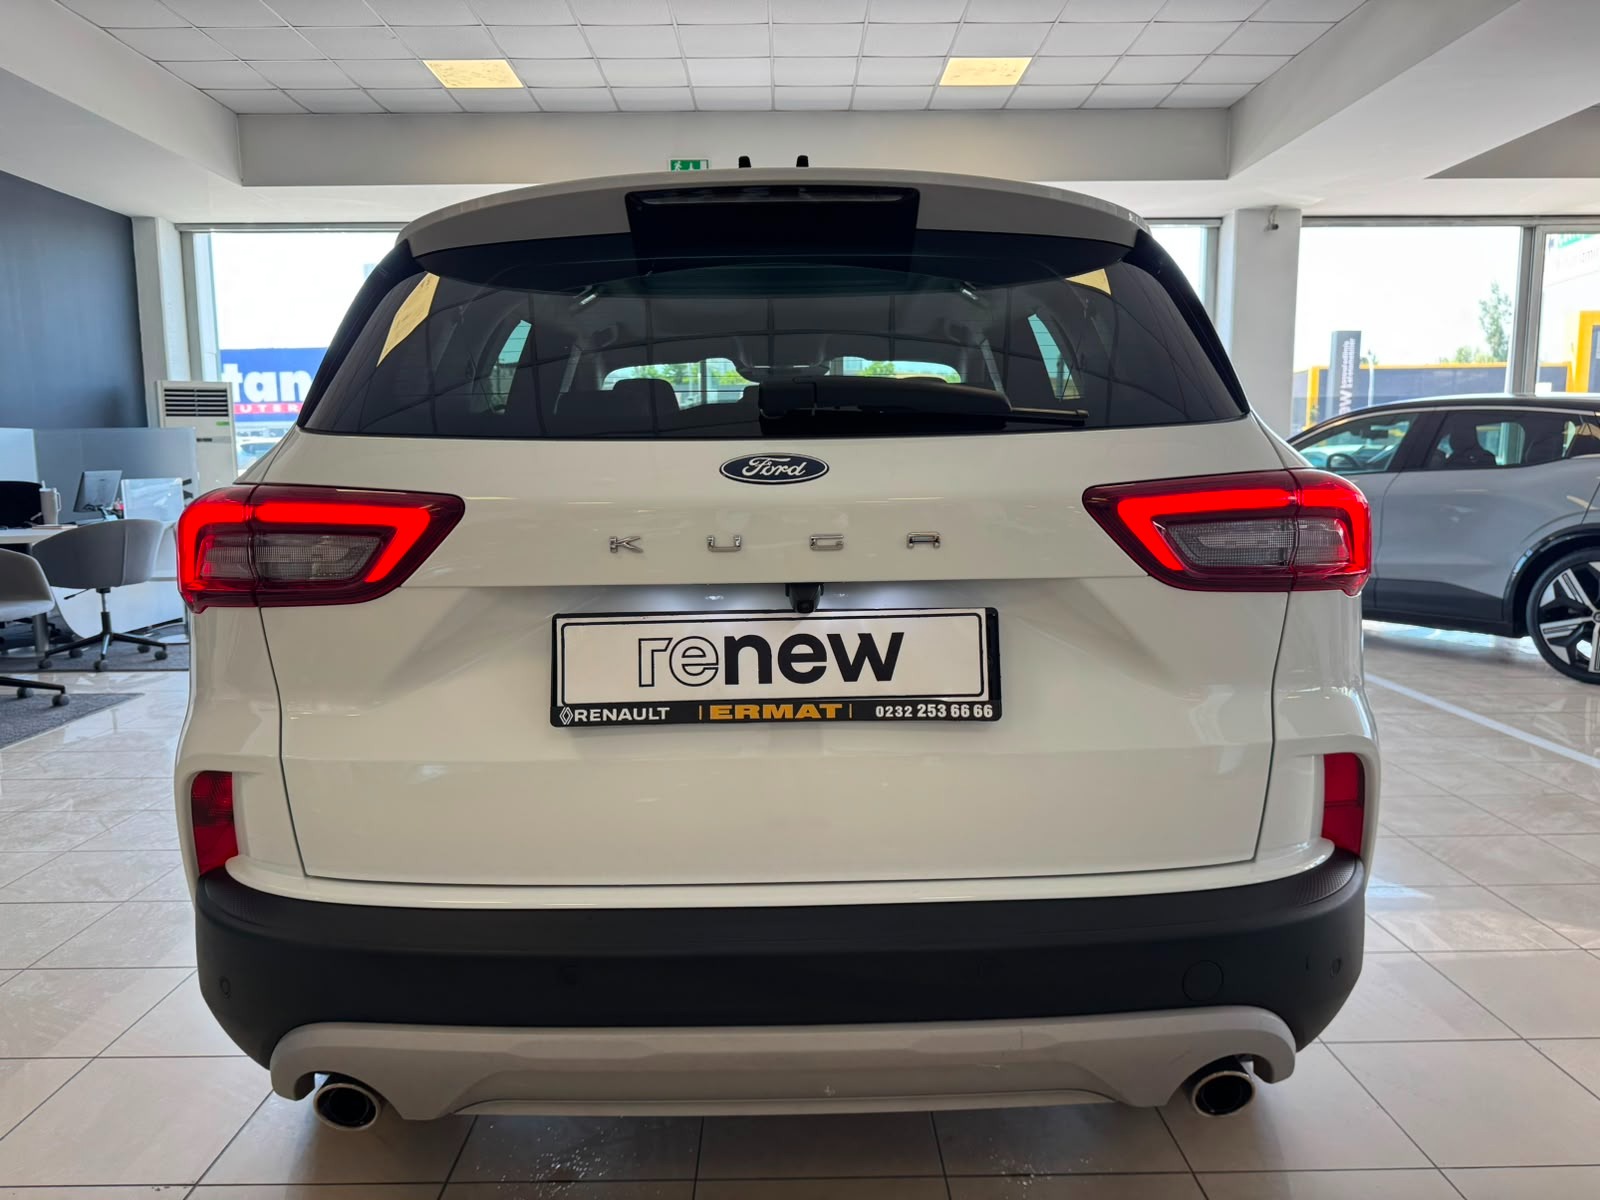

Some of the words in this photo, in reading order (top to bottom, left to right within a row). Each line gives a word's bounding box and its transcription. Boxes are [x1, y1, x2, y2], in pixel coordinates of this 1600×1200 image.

[741, 456, 806, 477] Ford
[609, 531, 941, 554] KUGA
[638, 632, 904, 687] renew
[574, 707, 670, 722] RENAULT
[709, 703, 843, 720] ERMAT
[875, 706, 913, 717] 0232
[916, 704, 947, 717] 253
[950, 704, 970, 717] 66
[973, 704, 993, 717] 66
